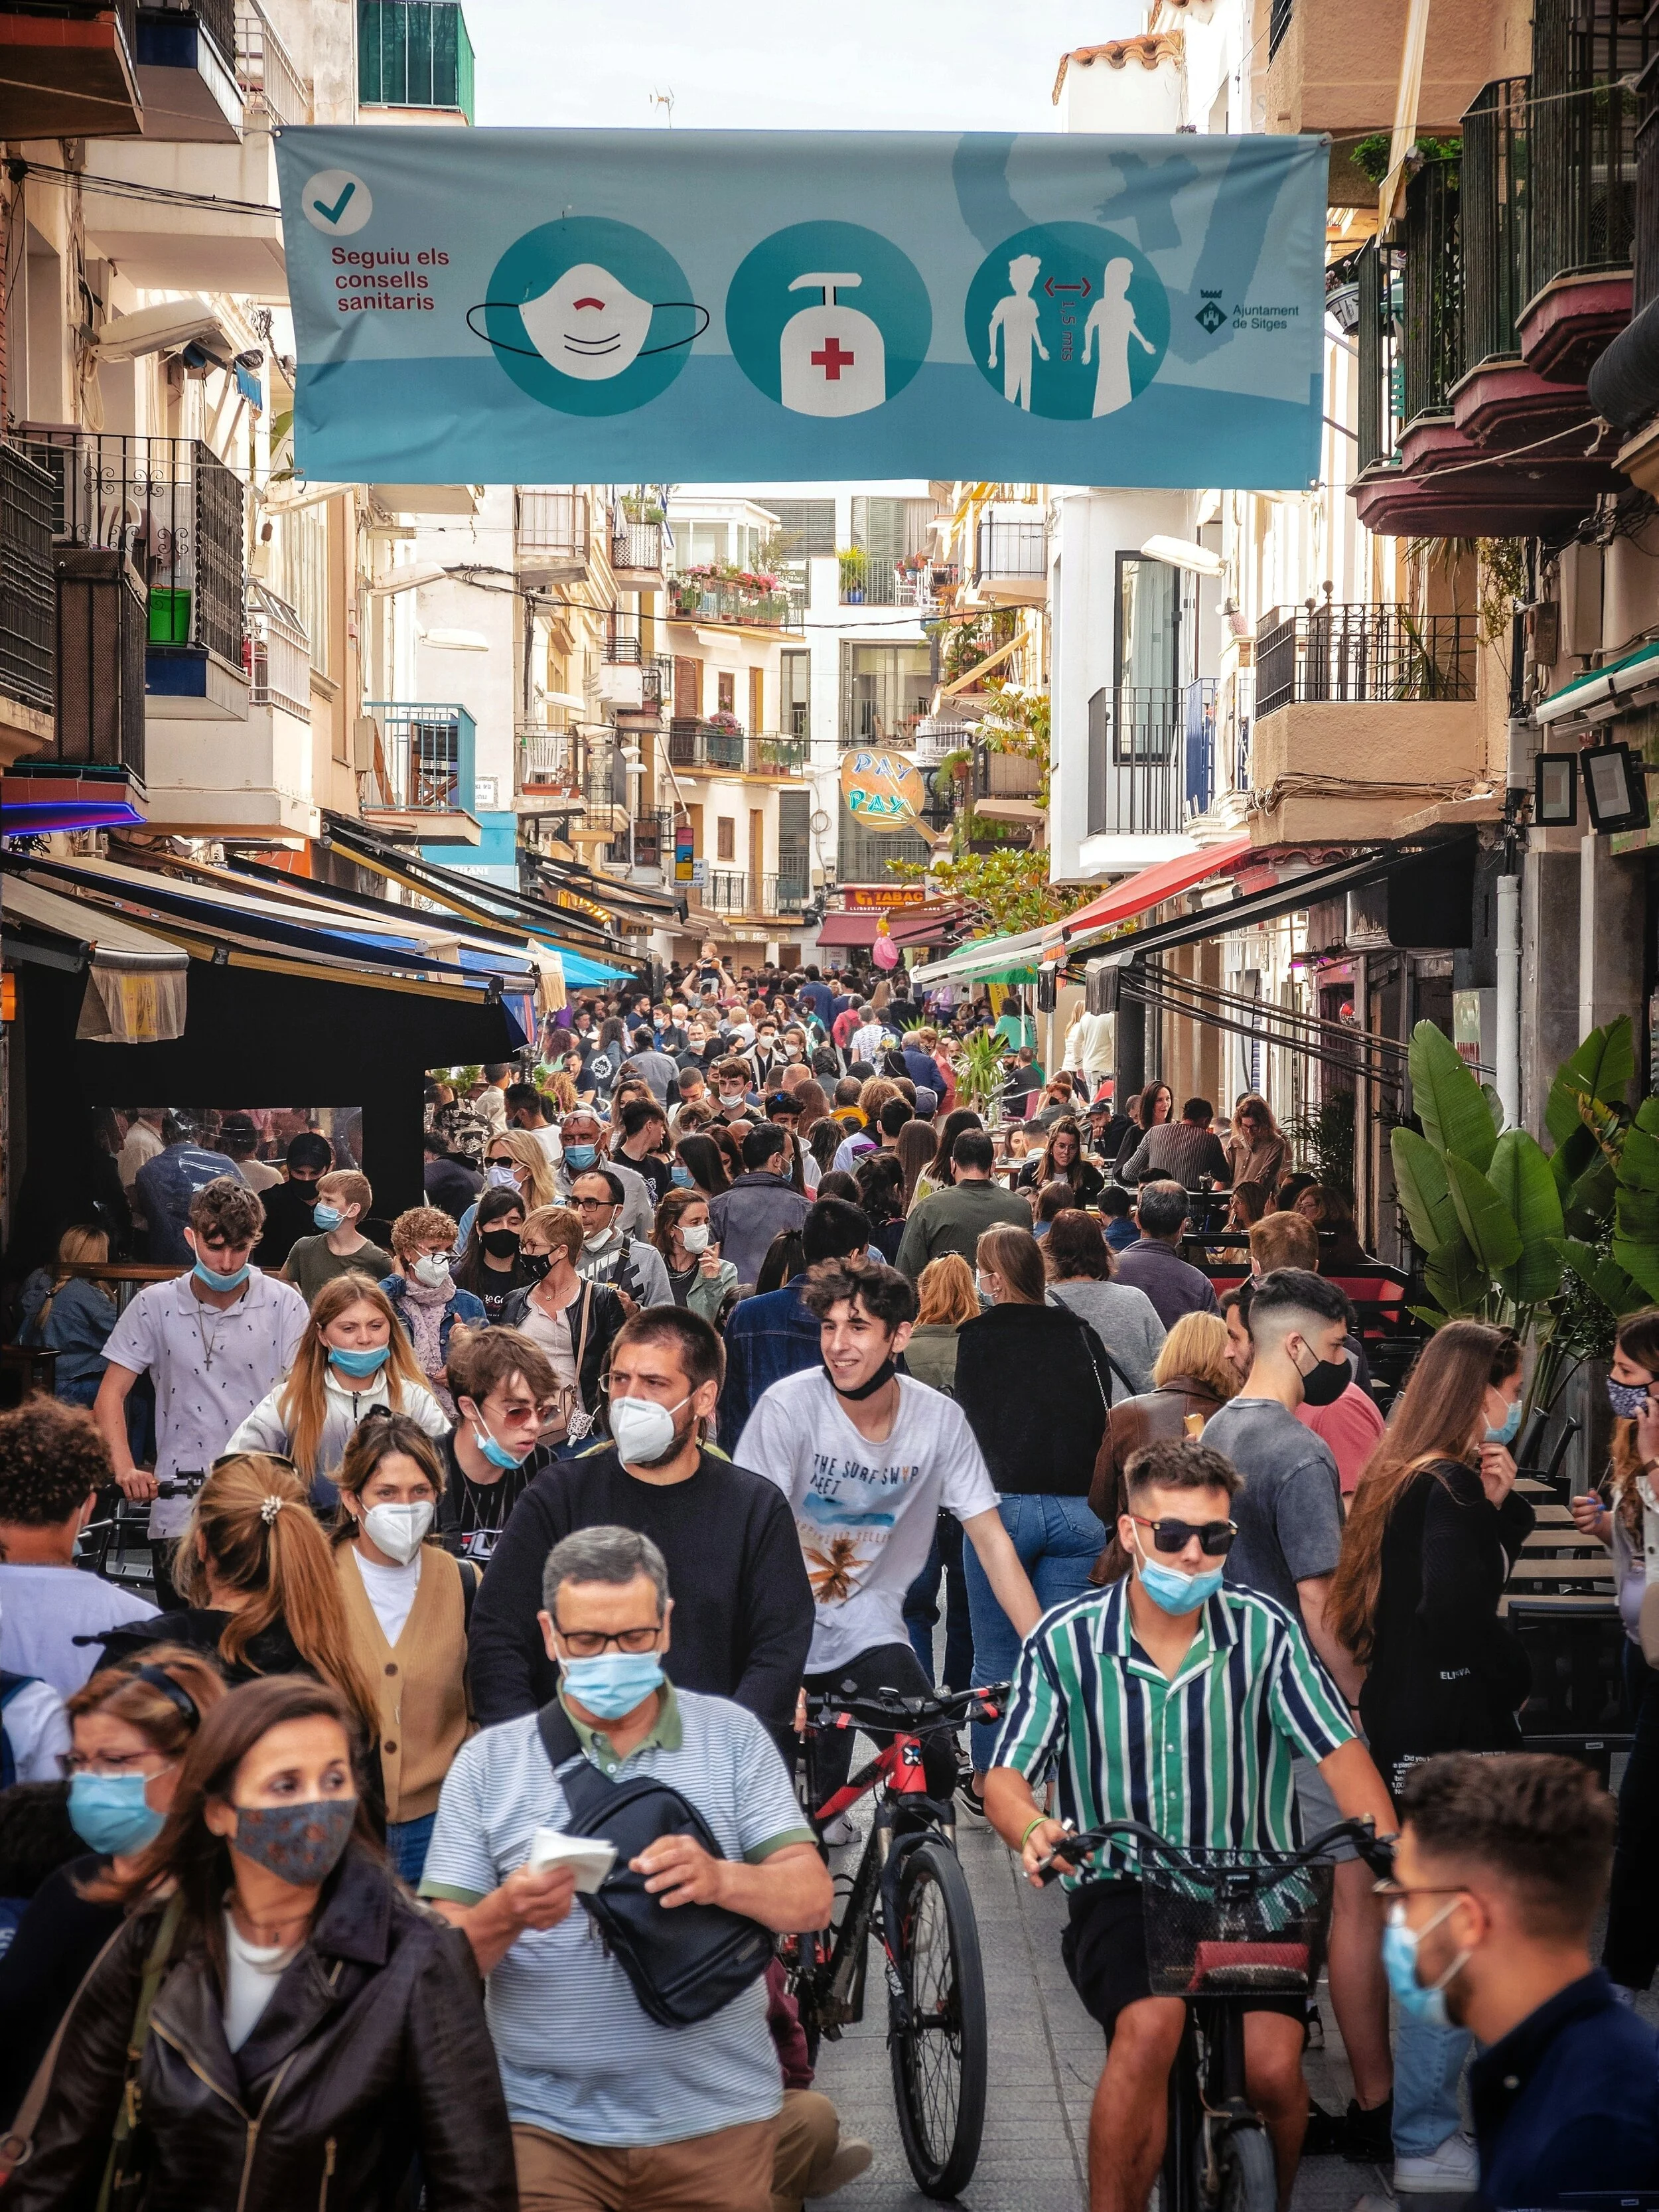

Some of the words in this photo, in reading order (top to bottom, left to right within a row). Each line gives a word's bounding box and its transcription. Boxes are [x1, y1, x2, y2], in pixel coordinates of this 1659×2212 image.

[331, 247, 410, 269] Seguiu
[417, 248, 449, 265] els
[335, 271, 429, 289] consells
[338, 292, 435, 312] sanitaris
[1060, 301, 1075, 325] 1,5
[1232, 304, 1299, 318] Ajuntament
[1232, 319, 1247, 329] de
[1251, 319, 1287, 332] Sitges
[1062, 331, 1073, 361] mts
[851, 753, 914, 780] PAY
[849, 790, 908, 813] PAY
[814, 1453, 837, 1476] THE
[842, 1461, 879, 1485] SURF
